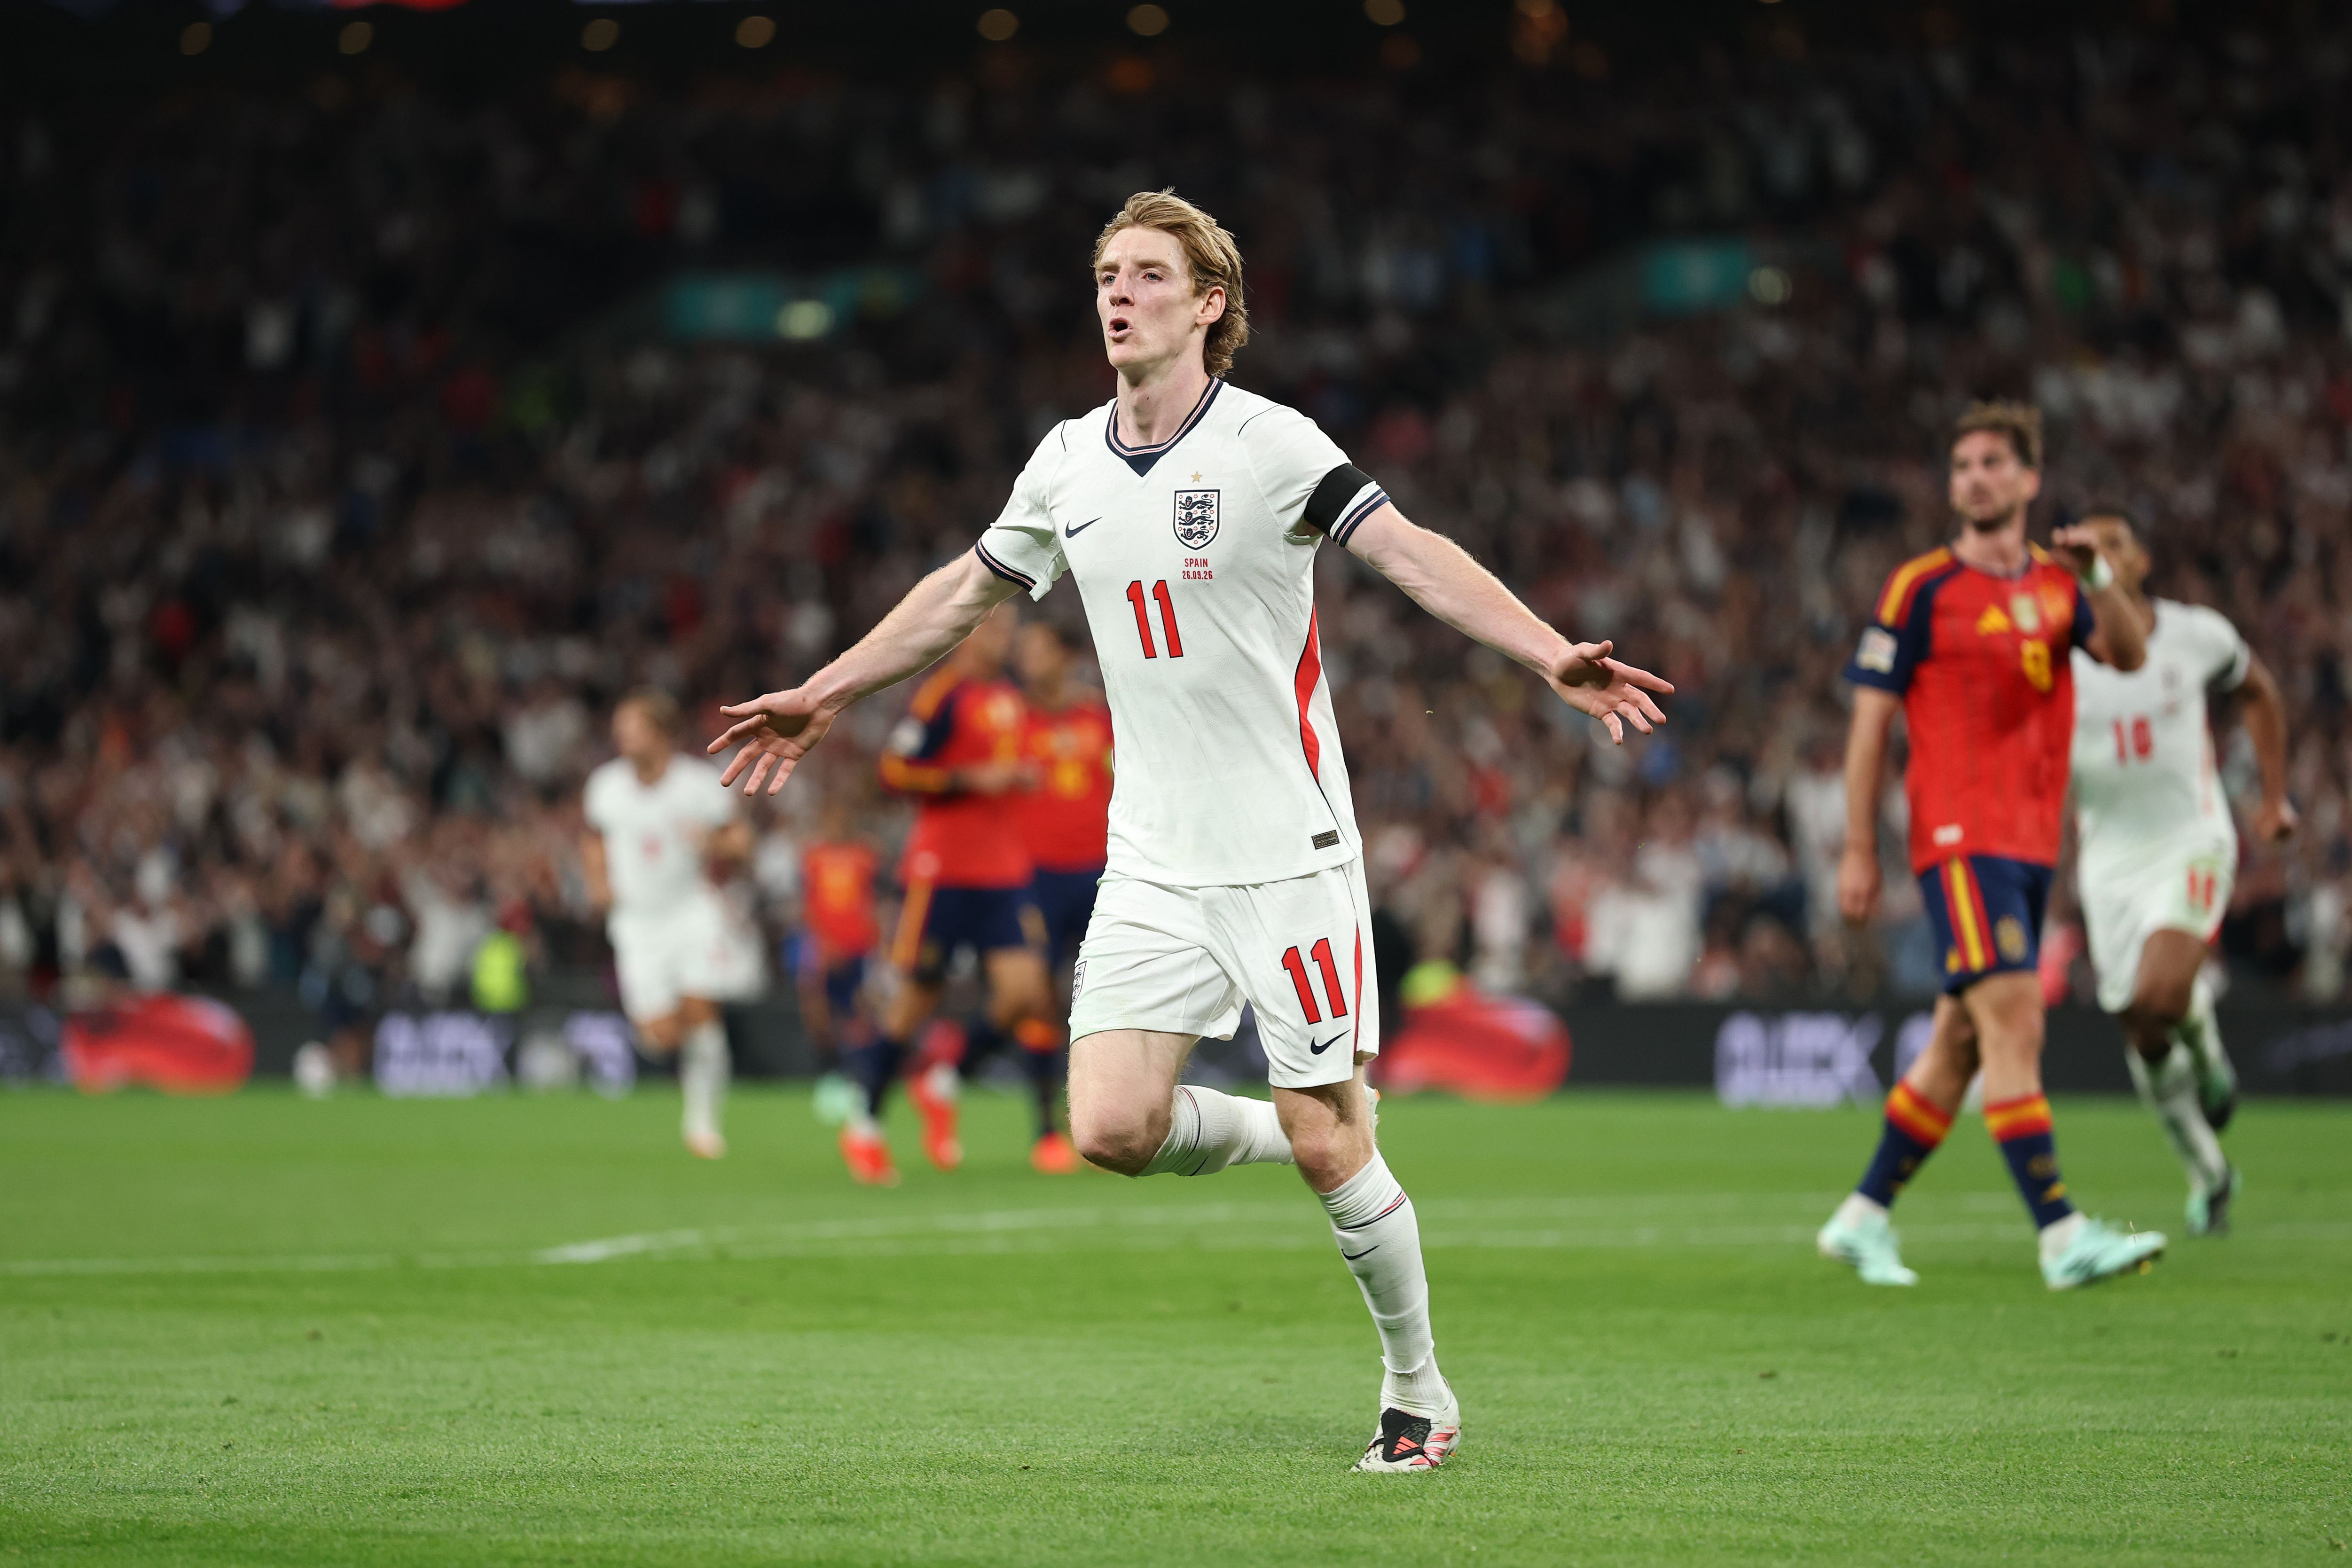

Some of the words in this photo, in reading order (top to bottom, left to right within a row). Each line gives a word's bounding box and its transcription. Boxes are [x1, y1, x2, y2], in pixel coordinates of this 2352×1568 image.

[1182, 570, 1213, 580] 26.09.26
[1184, 558, 1208, 567] SPAIN
[1126, 580, 1184, 659] 11
[2112, 716, 2153, 765] 10
[1281, 937, 1348, 1025] 11
